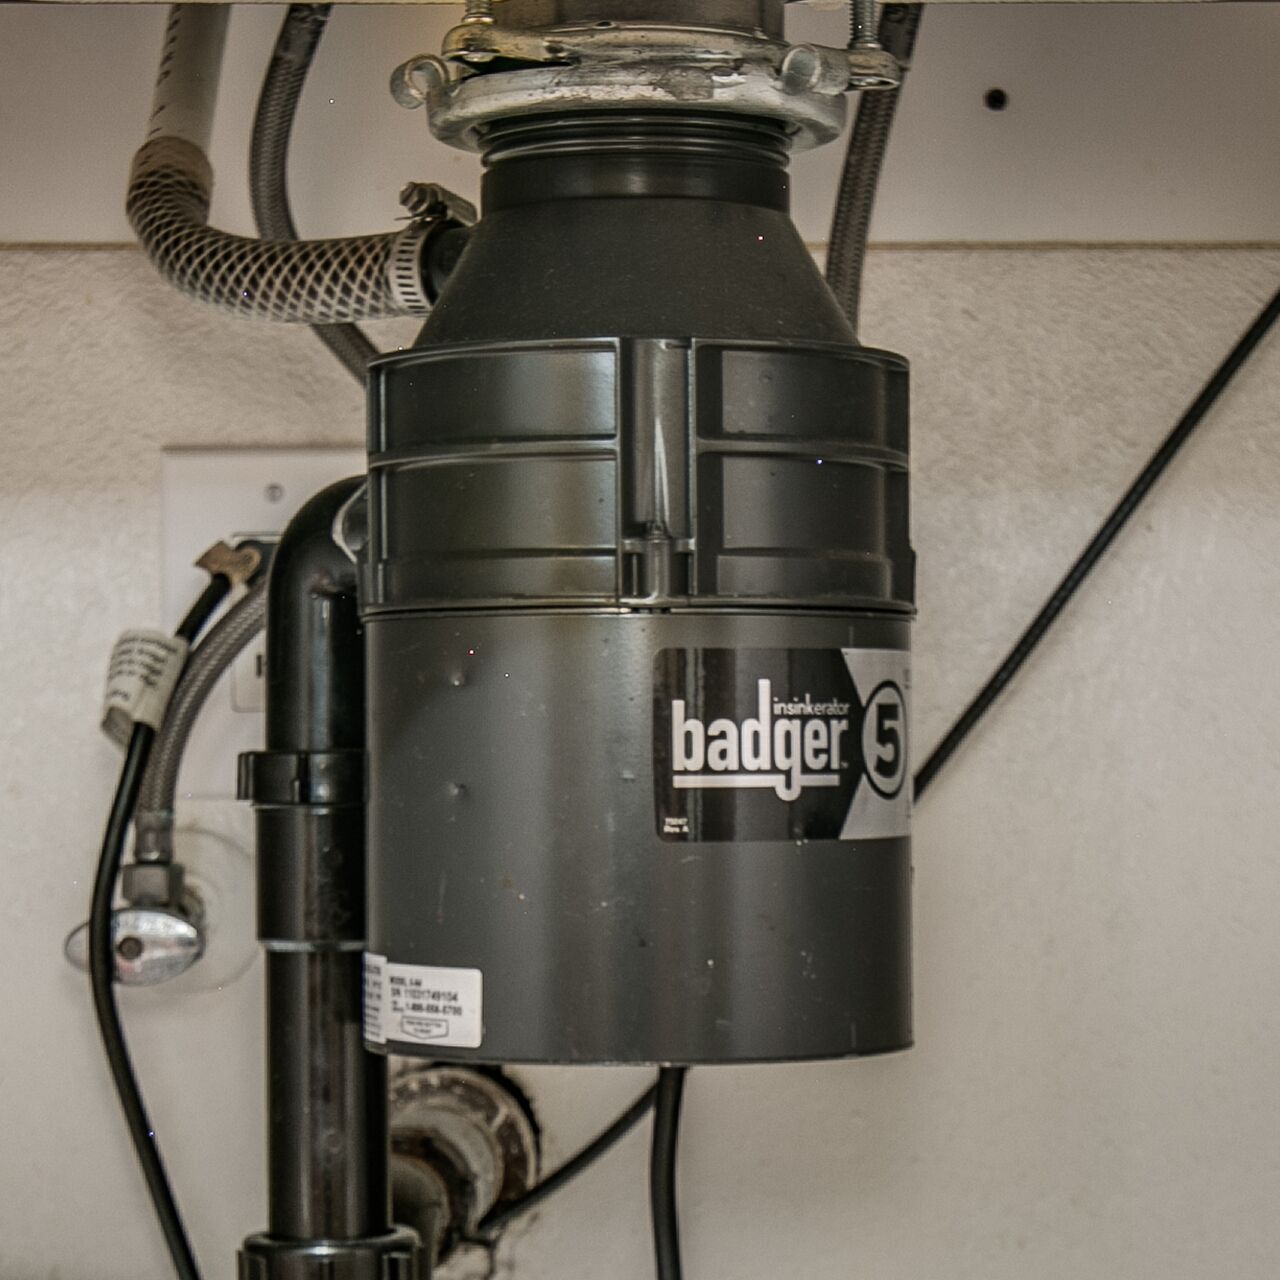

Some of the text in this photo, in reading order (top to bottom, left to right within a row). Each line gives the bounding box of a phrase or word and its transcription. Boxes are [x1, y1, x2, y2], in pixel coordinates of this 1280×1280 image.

[672, 678, 900, 801] badger 5
[773, 693, 850, 715] insinkerator
